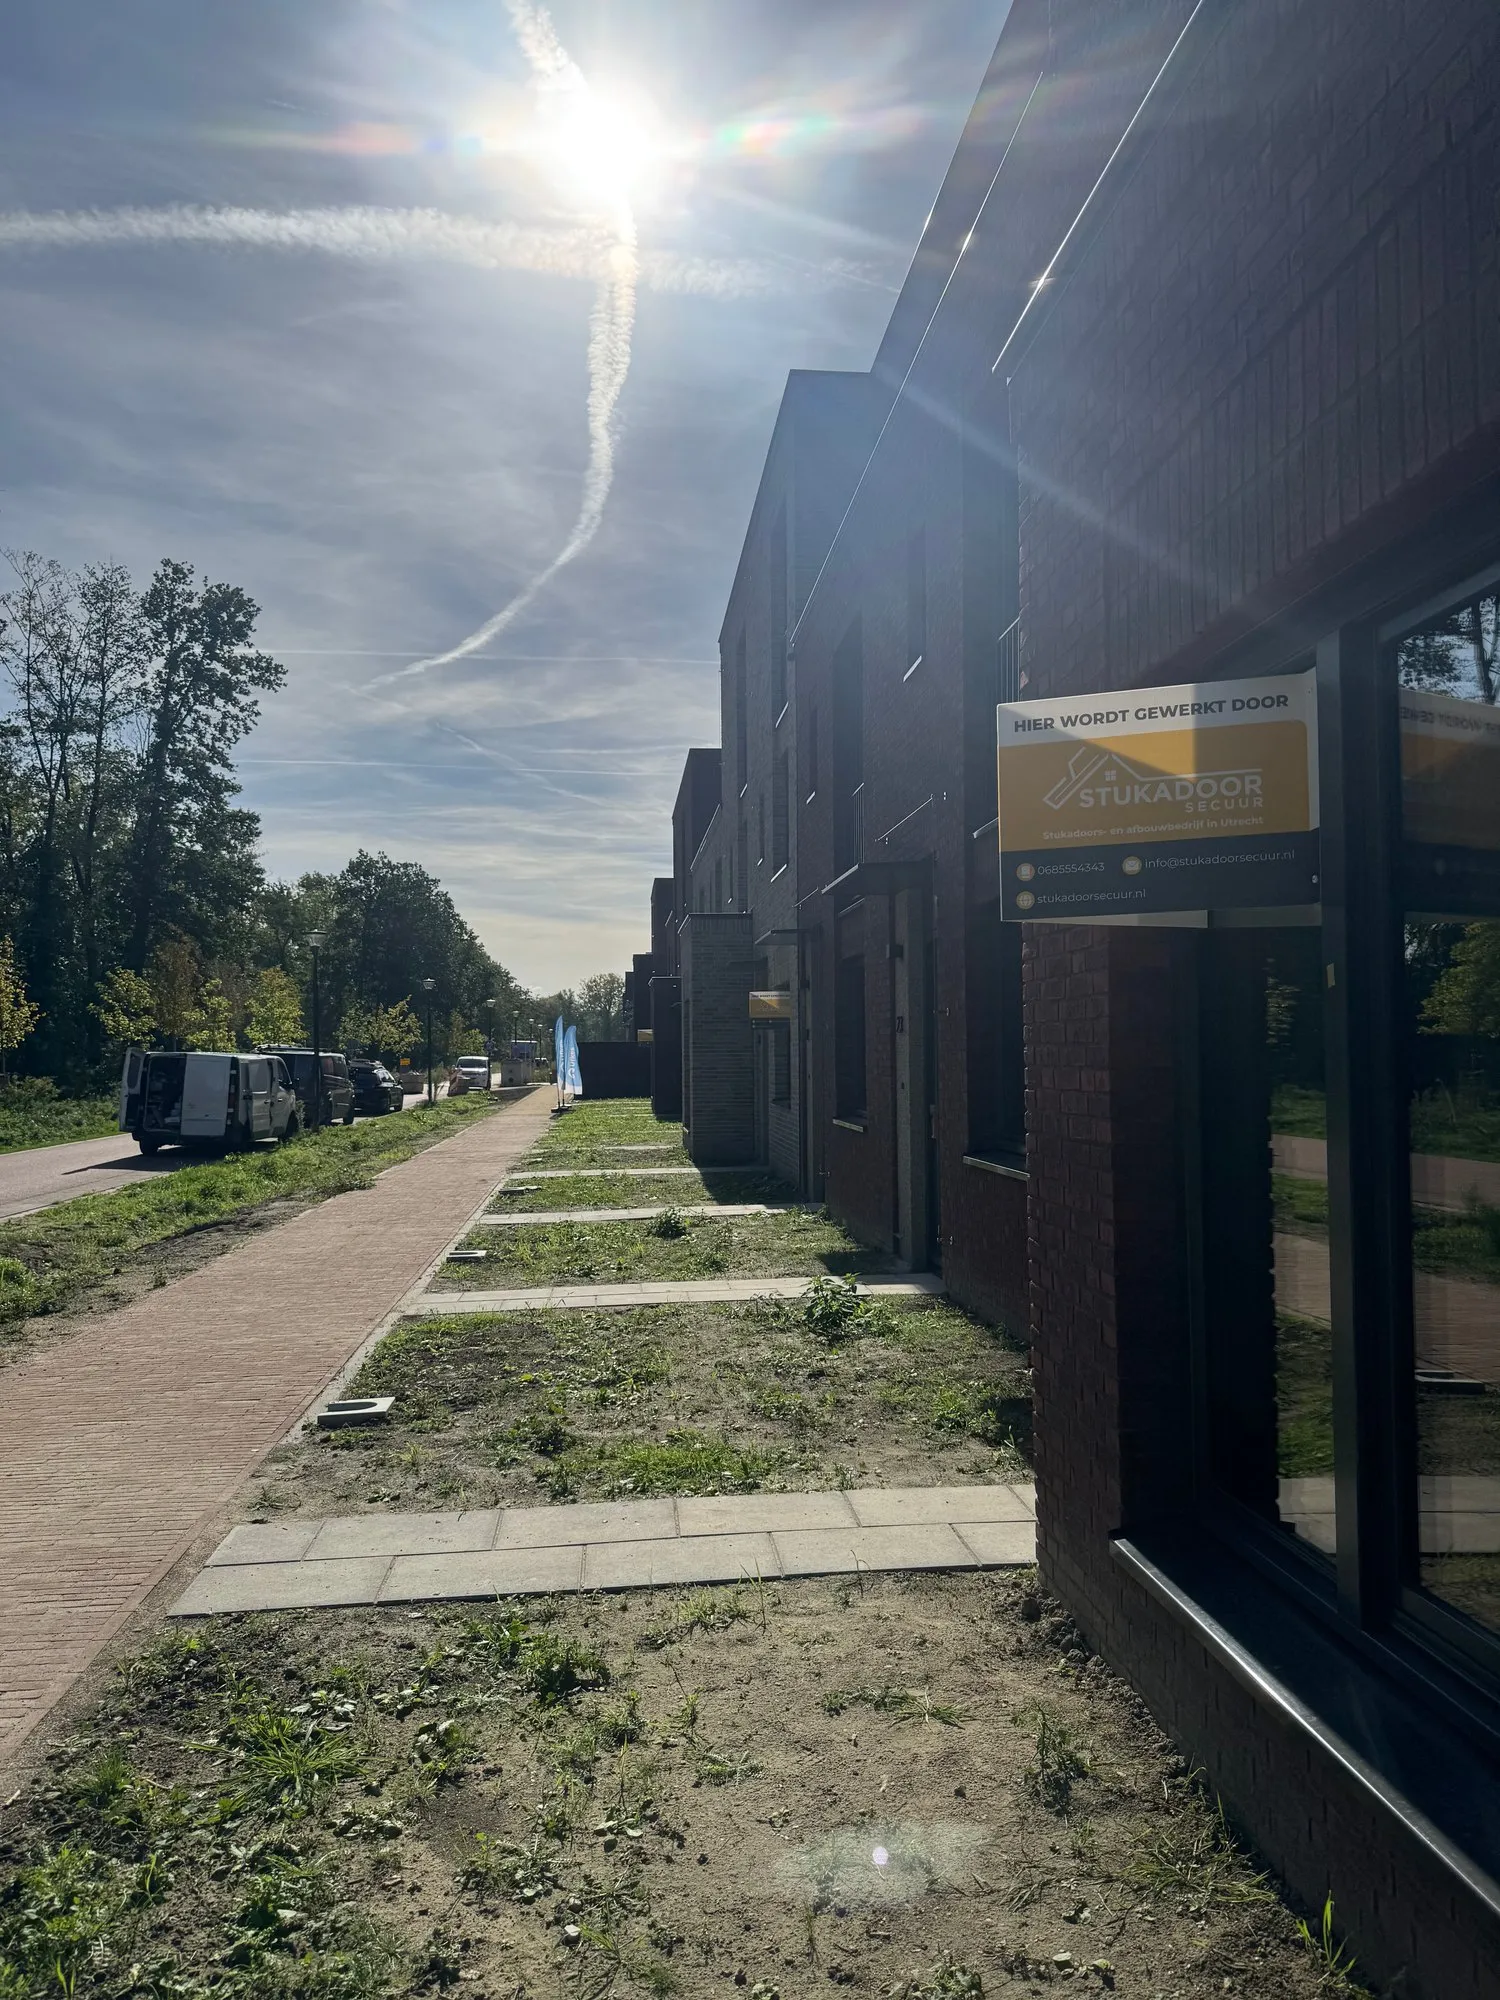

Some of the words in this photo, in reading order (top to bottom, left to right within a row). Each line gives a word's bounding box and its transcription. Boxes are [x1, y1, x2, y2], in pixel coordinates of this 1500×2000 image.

[1014, 717, 1055, 733] HIER
[1059, 709, 1130, 728] WORDT
[1134, 700, 1227, 721] GEWERKT
[1231, 694, 1289, 712] DOOR
[1079, 774, 1263, 808] STUKADOOR
[1185, 796, 1263, 813] SECUUR
[1042, 829, 1106, 840] Stukadoors-
[1110, 827, 1123, 835] en
[1126, 819, 1204, 834] afbouwbedrijf
[1207, 818, 1217, 828] in
[1221, 816, 1264, 827] Utrecht
[1037, 862, 1105, 876] 0685554343
[1144, 850, 1295, 869] info@stukadoorsecuur.nl
[1037, 888, 1146, 904] stukadoorsecuur.nl
